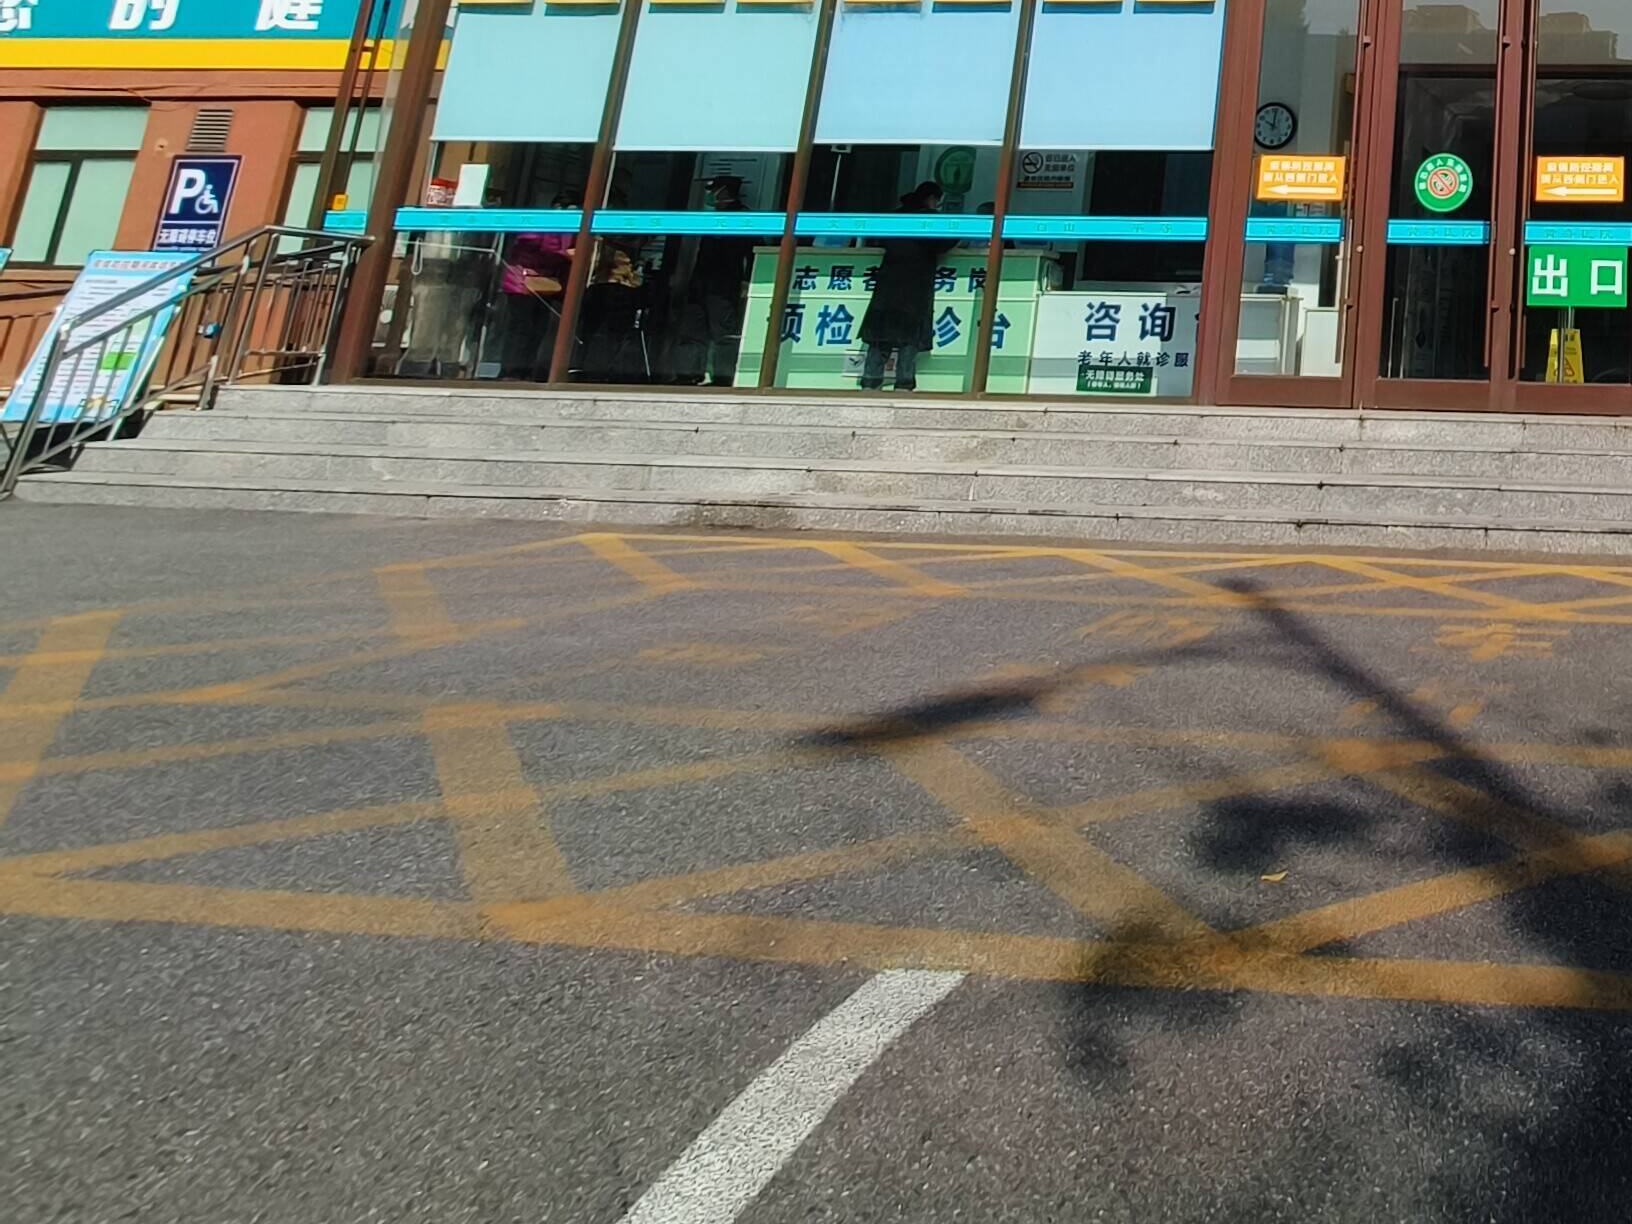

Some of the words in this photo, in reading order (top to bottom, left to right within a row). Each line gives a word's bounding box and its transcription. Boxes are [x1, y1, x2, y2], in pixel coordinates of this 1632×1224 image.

[169, 168, 206, 214] P
[792, 265, 986, 293] 志愿者务岗
[1531, 254, 1623, 299] 出口
[1084, 301, 1200, 342] 咨询
